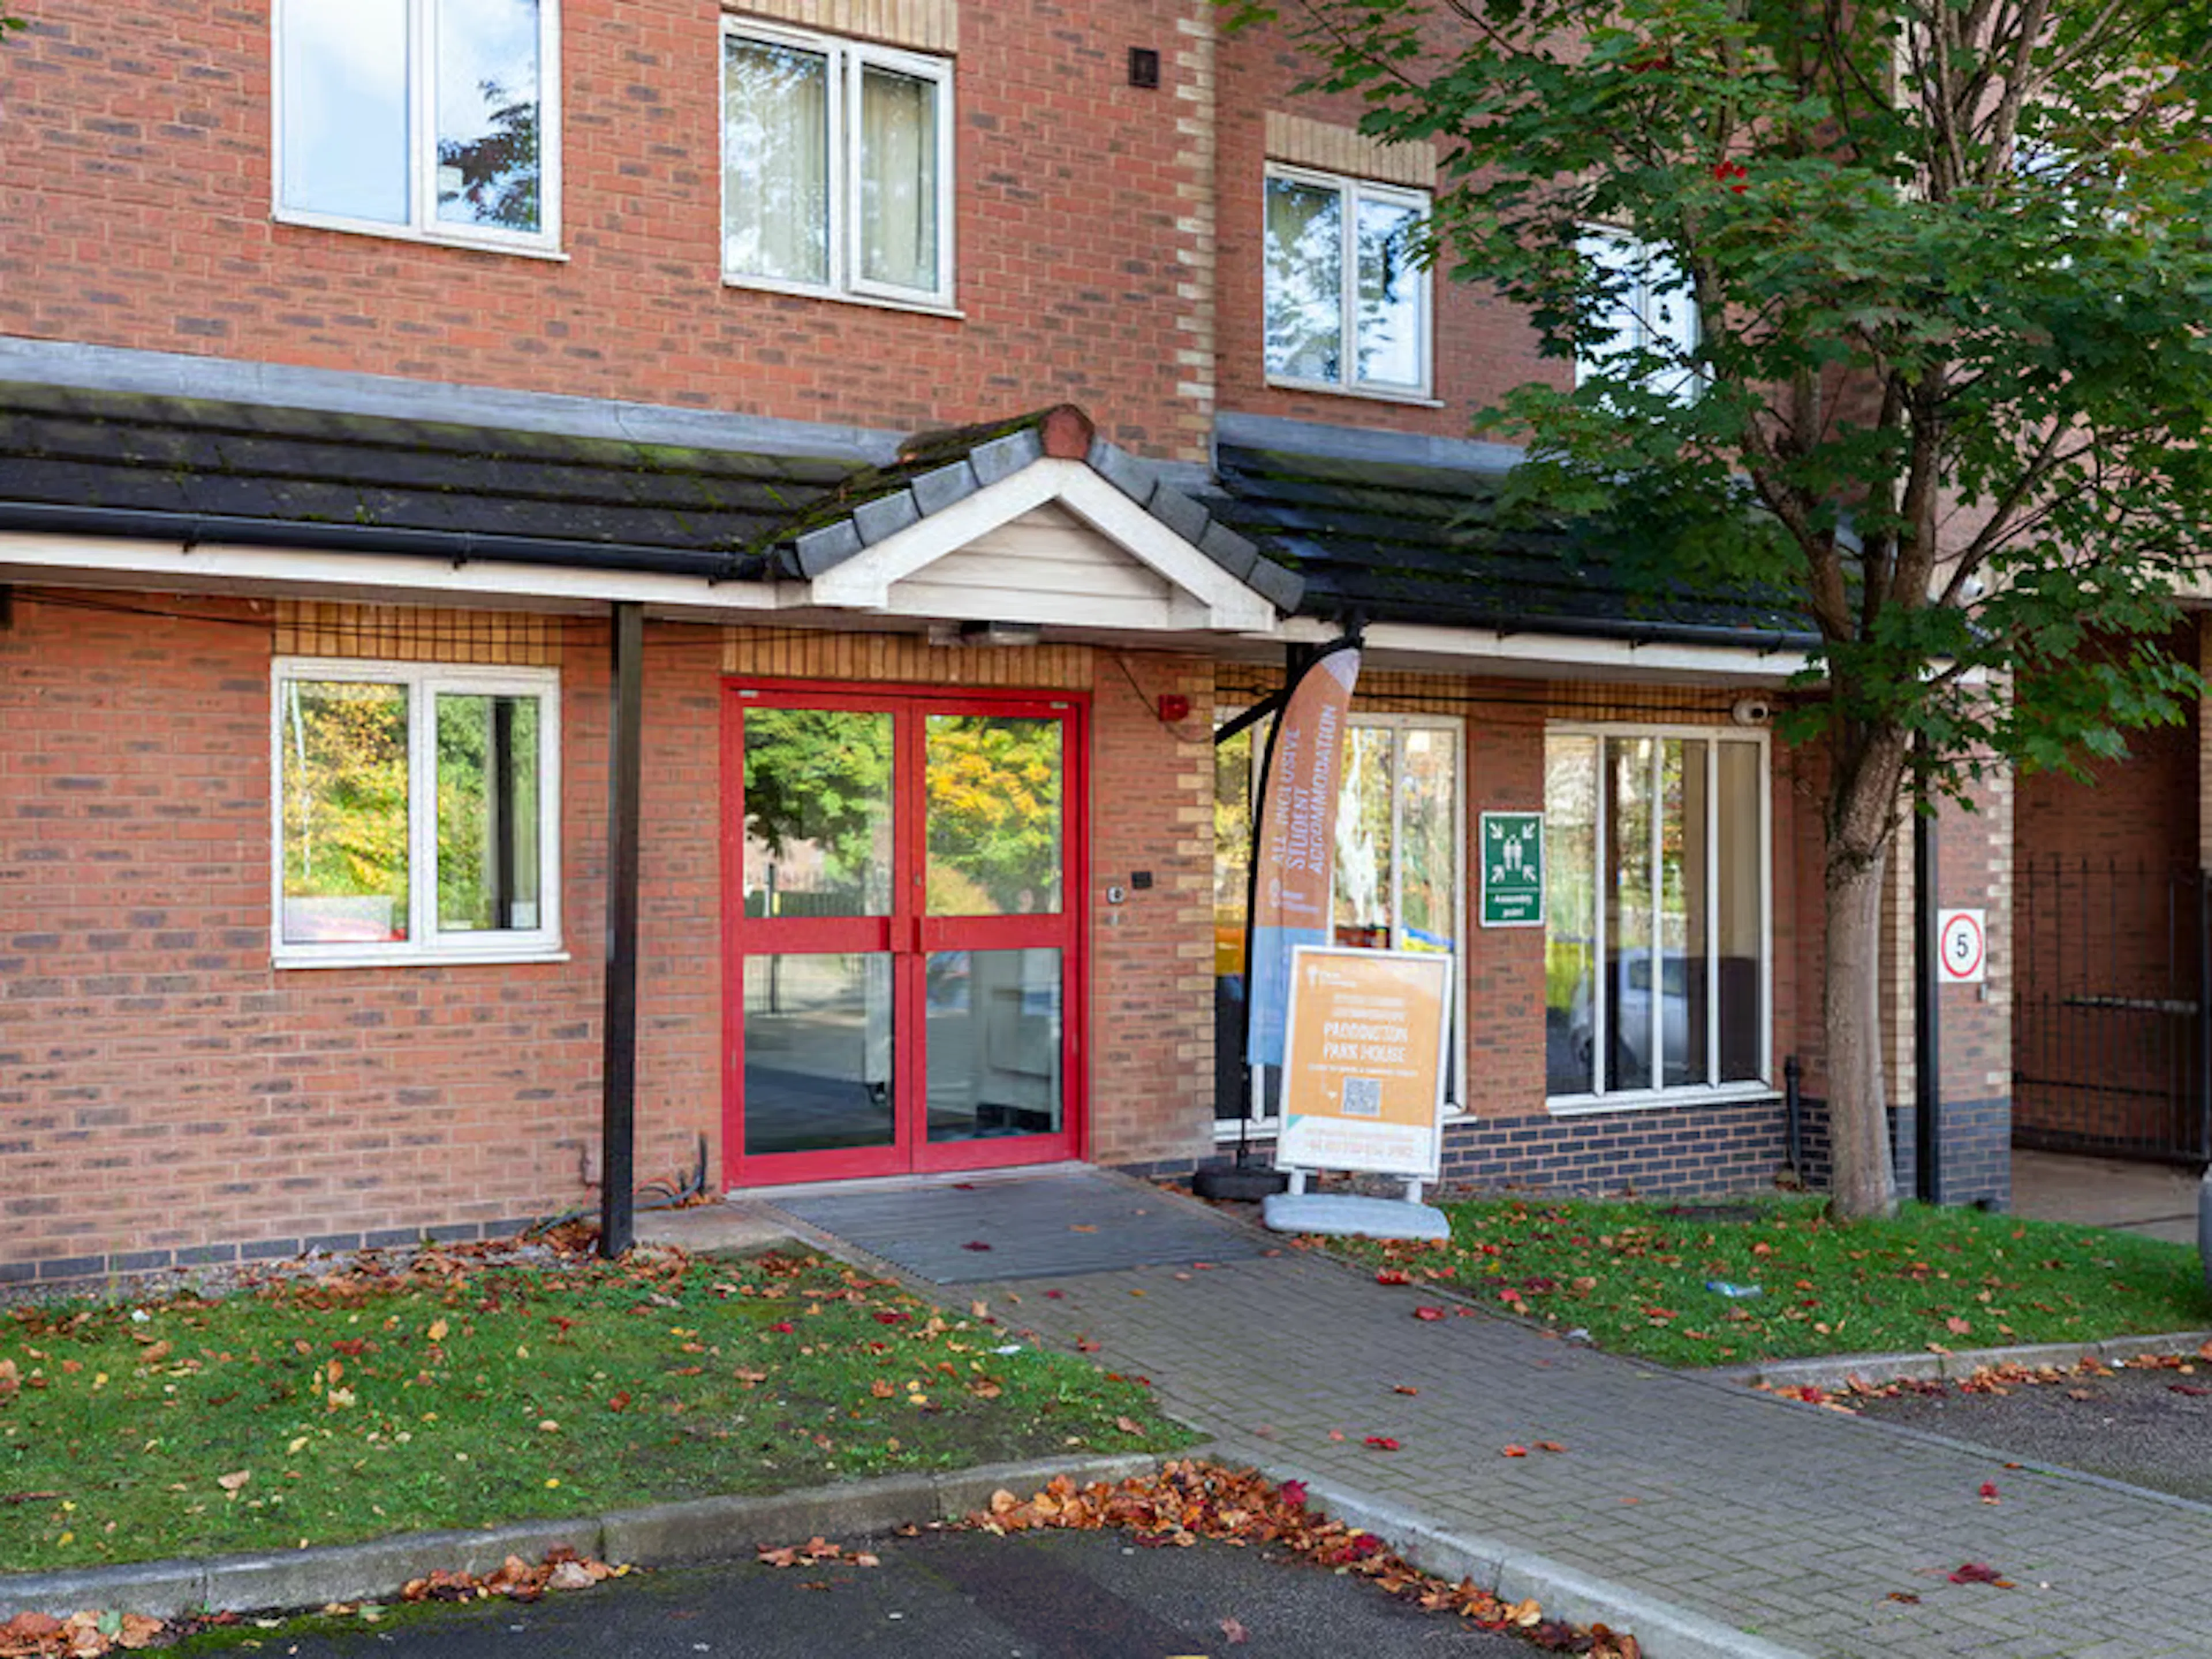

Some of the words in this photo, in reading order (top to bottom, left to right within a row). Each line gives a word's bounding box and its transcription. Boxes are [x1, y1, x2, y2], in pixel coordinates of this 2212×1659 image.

[1308, 703, 1337, 874] ACCOMMODATION
[1286, 786, 1309, 870] STUDENT
[1955, 933, 1969, 958] 5
[1360, 1044, 1406, 1063] HOUSE
